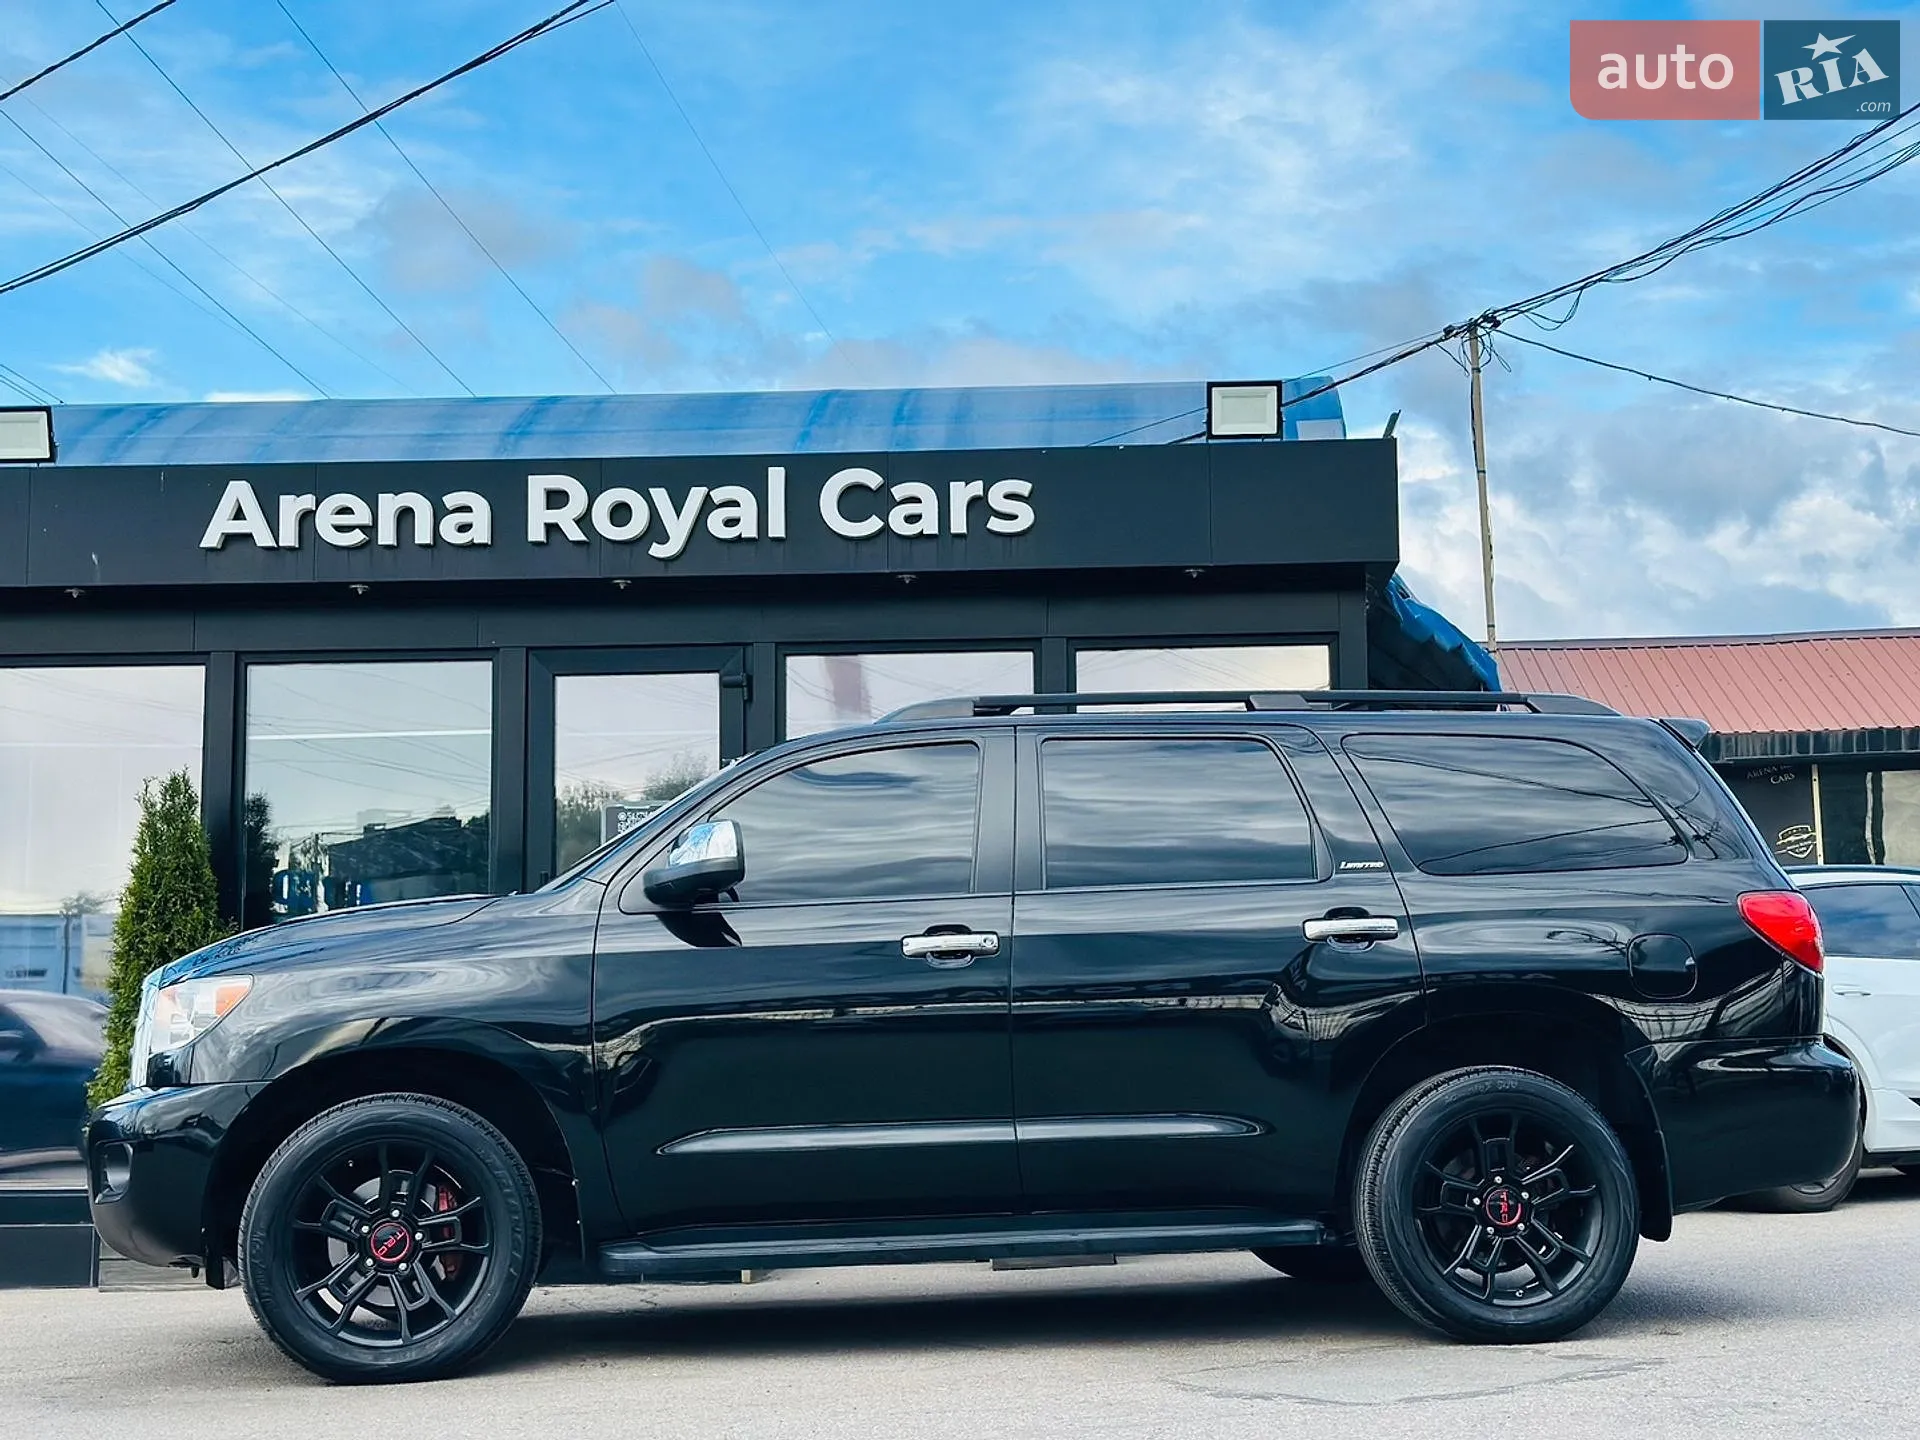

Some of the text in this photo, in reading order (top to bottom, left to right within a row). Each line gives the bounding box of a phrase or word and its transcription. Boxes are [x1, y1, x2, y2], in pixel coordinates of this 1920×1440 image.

[199, 466, 1035, 560] Arena Royal Cars
